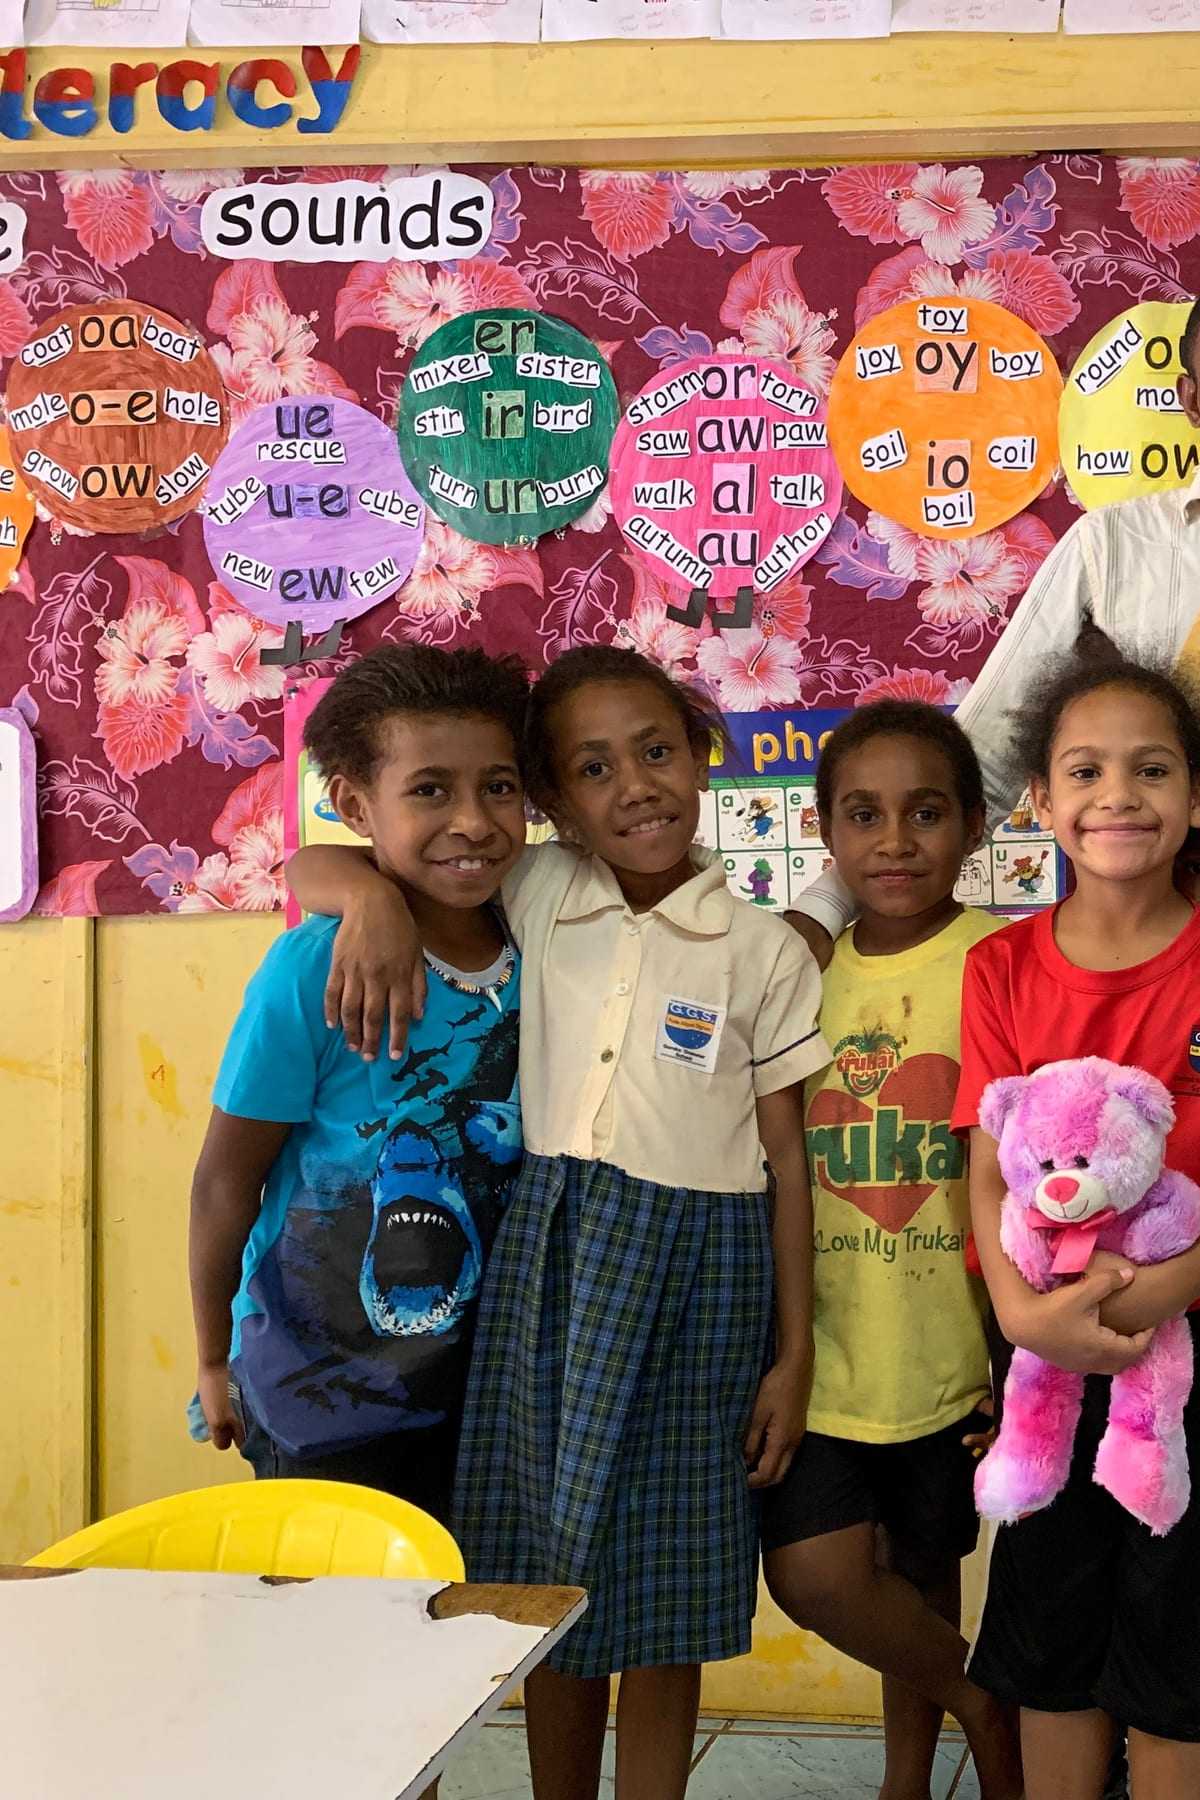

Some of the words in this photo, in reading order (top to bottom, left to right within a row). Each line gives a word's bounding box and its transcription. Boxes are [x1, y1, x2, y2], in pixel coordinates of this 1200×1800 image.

[216, 180, 485, 250] sounds
[80, 316, 137, 348] oa
[918, 304, 965, 333] toy
[21, 326, 71, 366] coat
[143, 317, 200, 360] boat
[475, 320, 533, 354] er
[414, 352, 486, 390] mixer
[520, 351, 598, 380] sister
[857, 346, 896, 380] joy
[915, 342, 977, 391] oy
[991, 350, 1039, 376] boy
[1075, 320, 1142, 392] round
[628, 371, 704, 424] storm
[702, 364, 755, 399] or
[761, 371, 816, 414] torn
[11, 393, 65, 430] mole
[71, 391, 155, 425] o-e
[165, 389, 219, 417] hole
[416, 405, 460, 434] stir
[486, 392, 523, 437] ir
[535, 399, 590, 426] bird
[276, 405, 332, 439] ue
[697, 417, 765, 453] aw
[773, 423, 825, 448] paw
[258, 441, 343, 461] rescue
[638, 432, 688, 451] saw
[862, 430, 906, 467] soil
[988, 438, 1035, 463] coil
[1078, 445, 1128, 470] how
[23, 451, 77, 494] grow
[82, 465, 152, 497] ow
[156, 456, 203, 504] slow
[927, 440, 969, 488] io
[208, 477, 262, 524] tube
[267, 484, 348, 518] u-e
[430, 465, 477, 507] turn
[484, 479, 535, 513] ur
[539, 466, 601, 503] burn
[634, 479, 693, 505] walk
[713, 463, 755, 514] al
[770, 475, 822, 502] talk
[359, 488, 418, 521] cube
[924, 492, 973, 522] boil
[628, 517, 713, 587] autumn
[698, 532, 756, 567] au
[754, 512, 826, 585] author
[223, 552, 273, 584] new
[279, 566, 343, 601] ew
[351, 558, 395, 597] few
[722, 795, 733, 807] a
[790, 793, 801, 805] e
[792, 856, 804, 869] o
[837, 1050, 895, 1072] trukai
[806, 1109, 966, 1184] ruka
[865, 1228, 896, 1263] My
[903, 1226, 965, 1252] Trukai
